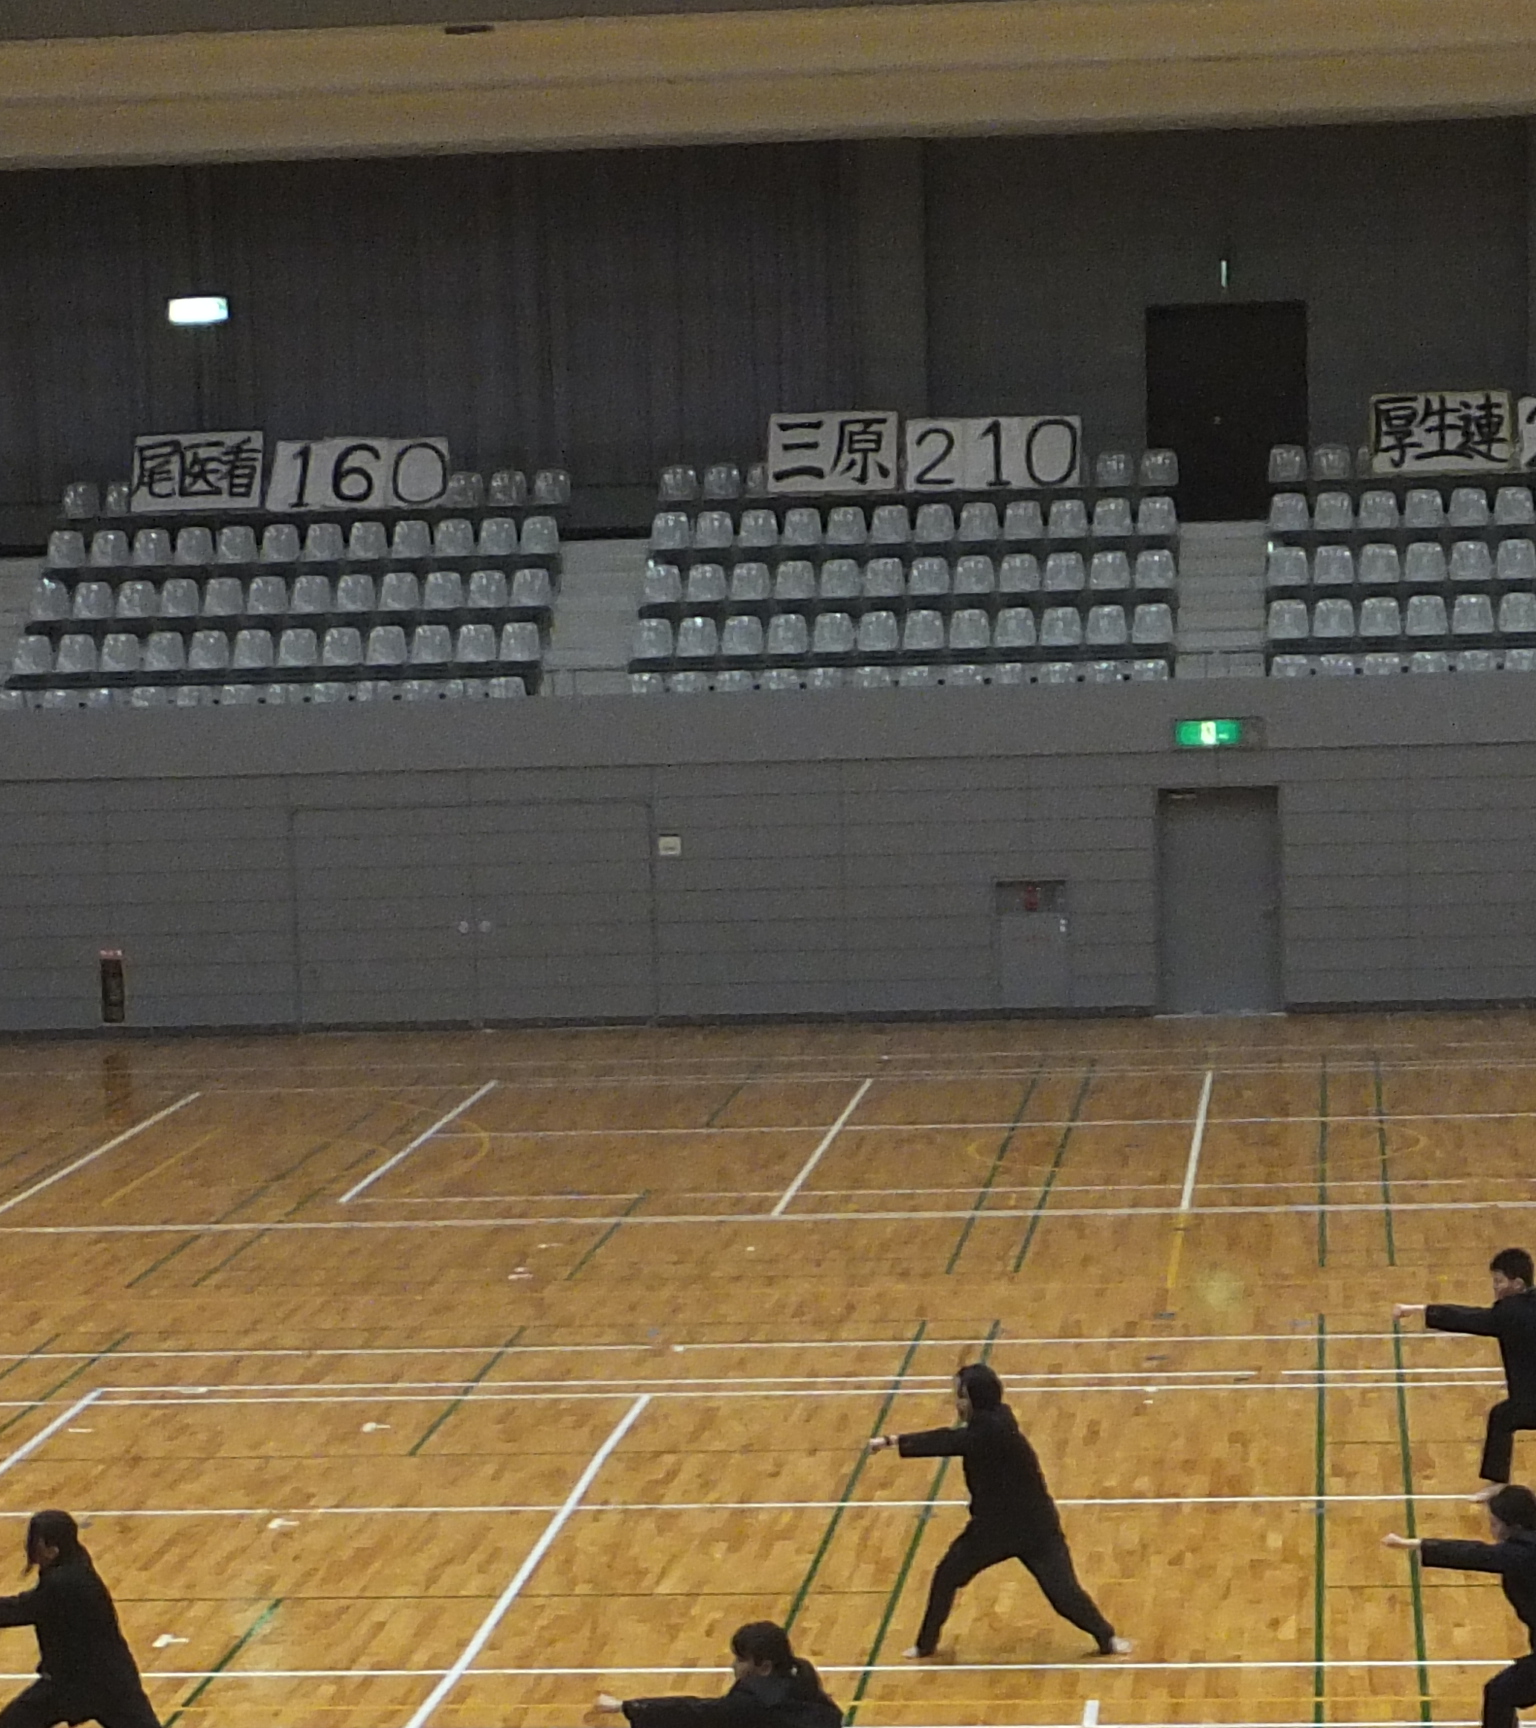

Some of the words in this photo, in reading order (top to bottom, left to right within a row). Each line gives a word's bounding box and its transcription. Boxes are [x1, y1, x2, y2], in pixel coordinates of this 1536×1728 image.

[772, 417, 890, 485] 三原
[915, 419, 1078, 487] 210
[1375, 393, 1508, 468] 厚生連
[128, 437, 262, 499] 尾医看
[288, 442, 448, 509] 160
